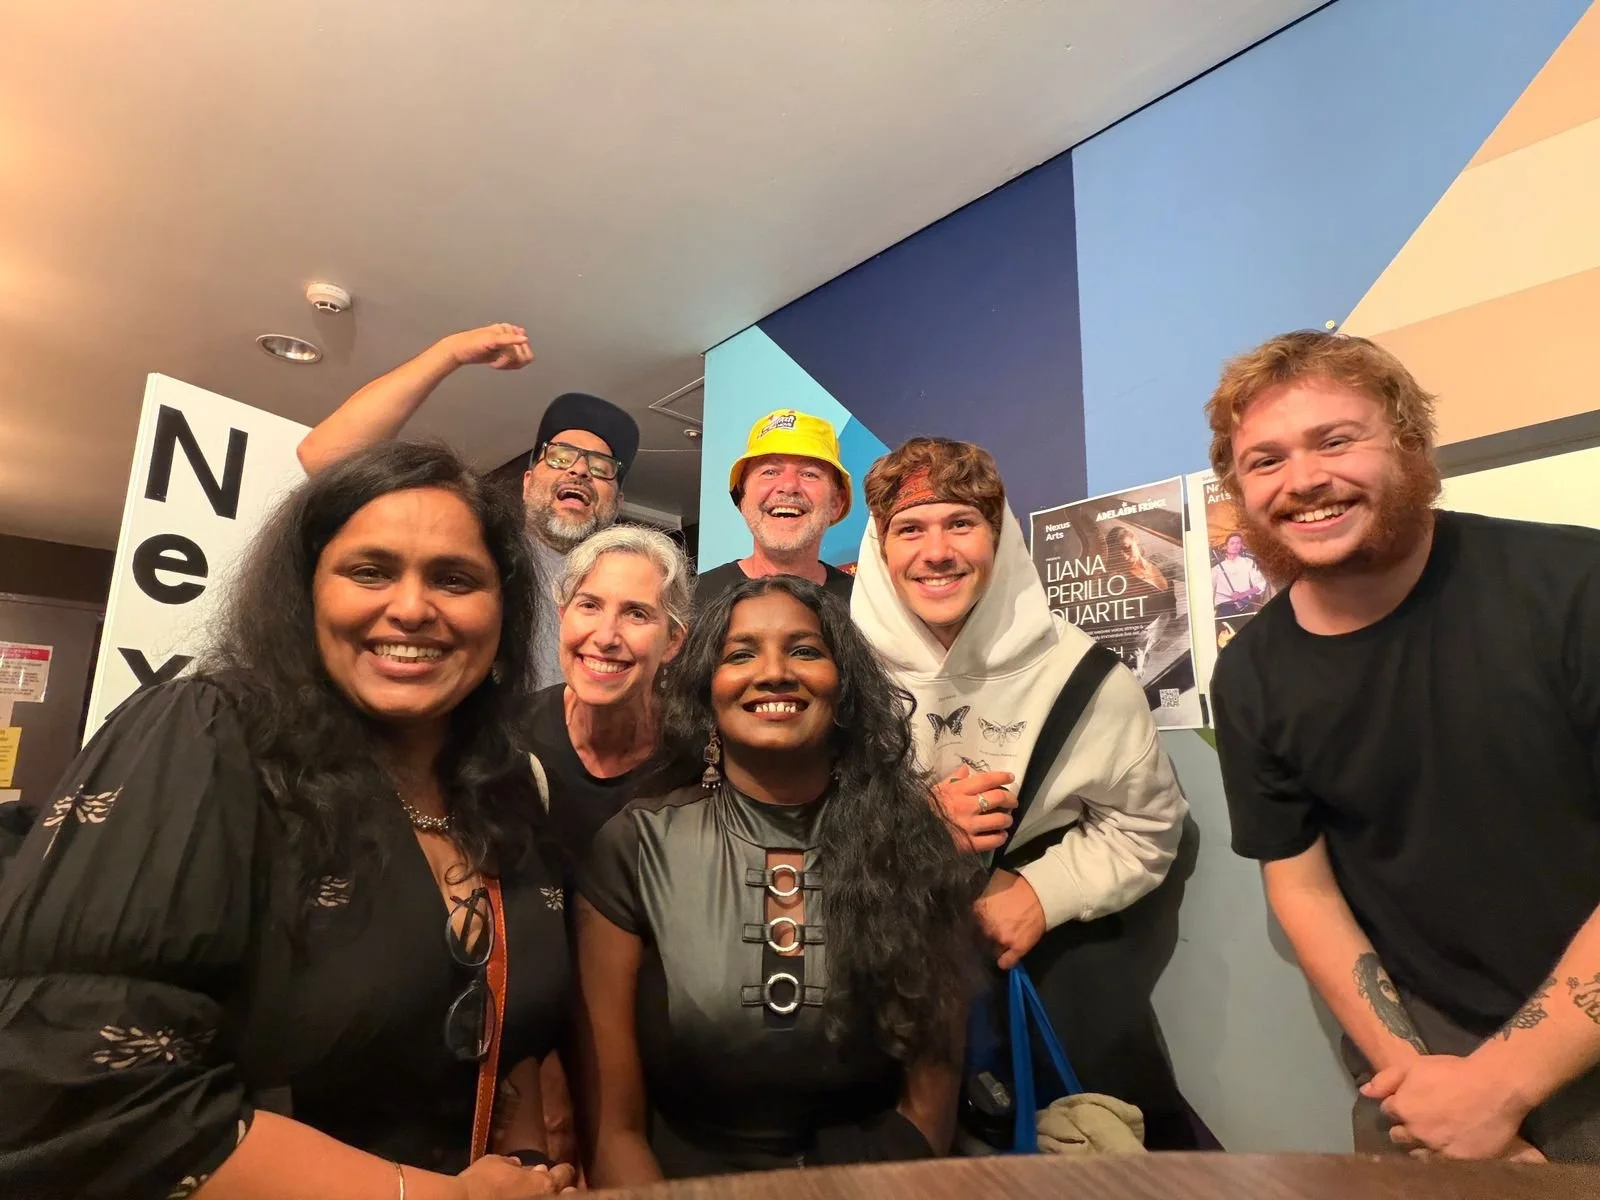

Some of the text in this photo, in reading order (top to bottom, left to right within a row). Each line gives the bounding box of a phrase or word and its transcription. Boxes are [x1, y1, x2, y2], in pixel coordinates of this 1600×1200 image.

[1045, 521, 1071, 533] Nexus
[1046, 531, 1064, 542] Arts
[1047, 554, 1107, 583] LIANA
[1047, 574, 1127, 607] PERILLO
